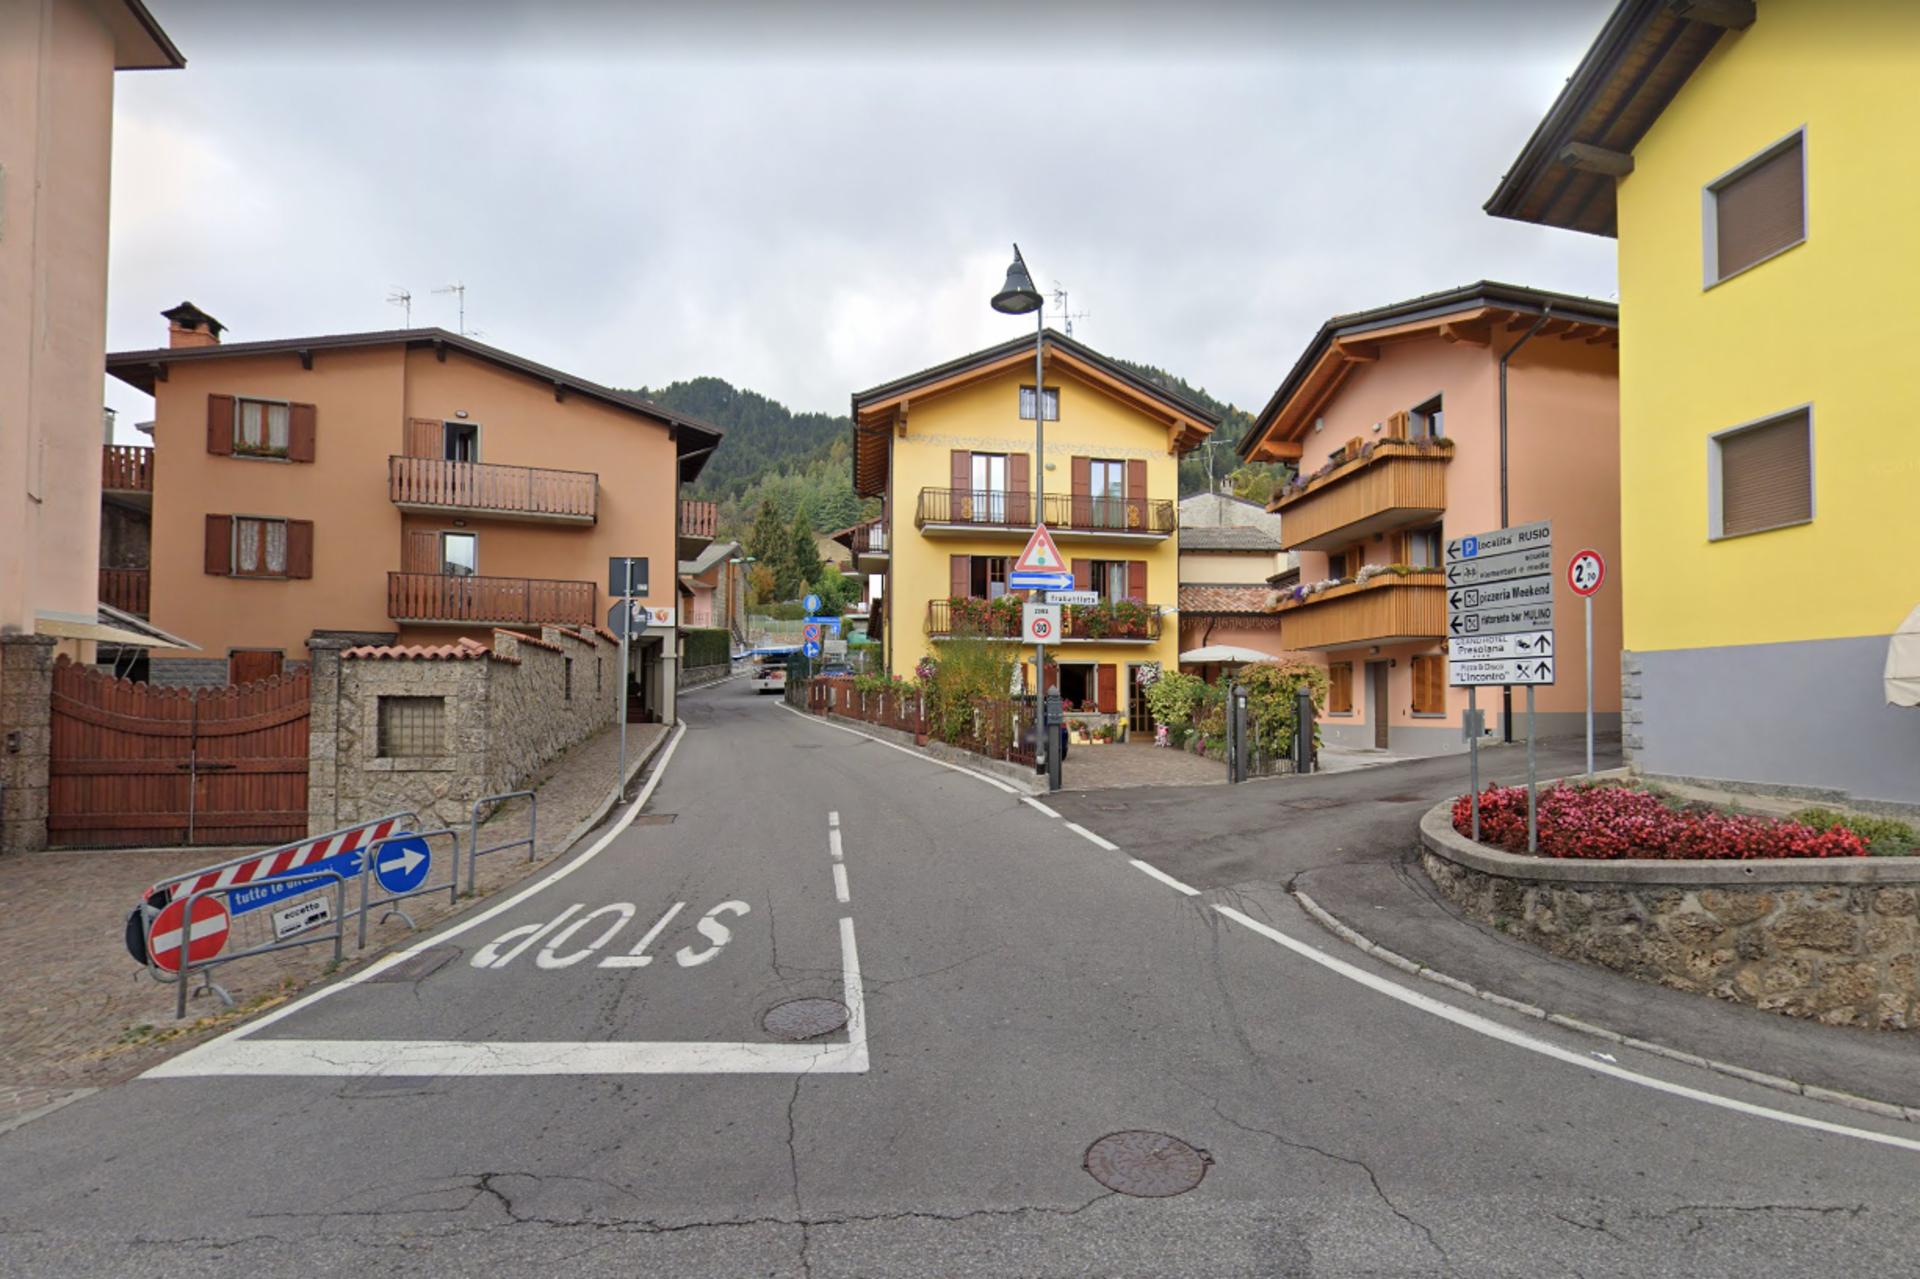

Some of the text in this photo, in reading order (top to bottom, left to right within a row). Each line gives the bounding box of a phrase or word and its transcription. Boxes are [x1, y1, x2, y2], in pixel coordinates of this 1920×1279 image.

[1518, 528, 1550, 542] RUSIO
[1575, 564, 1584, 583] 2
[1480, 583, 1550, 606] pizzeria Weekend
[1481, 608, 1551, 625] ristorante bar MULINO
[235, 887, 268, 905] tutte
[271, 884, 284, 895] le
[284, 903, 320, 919] eccetto
[470, 900, 751, 969] STOP
